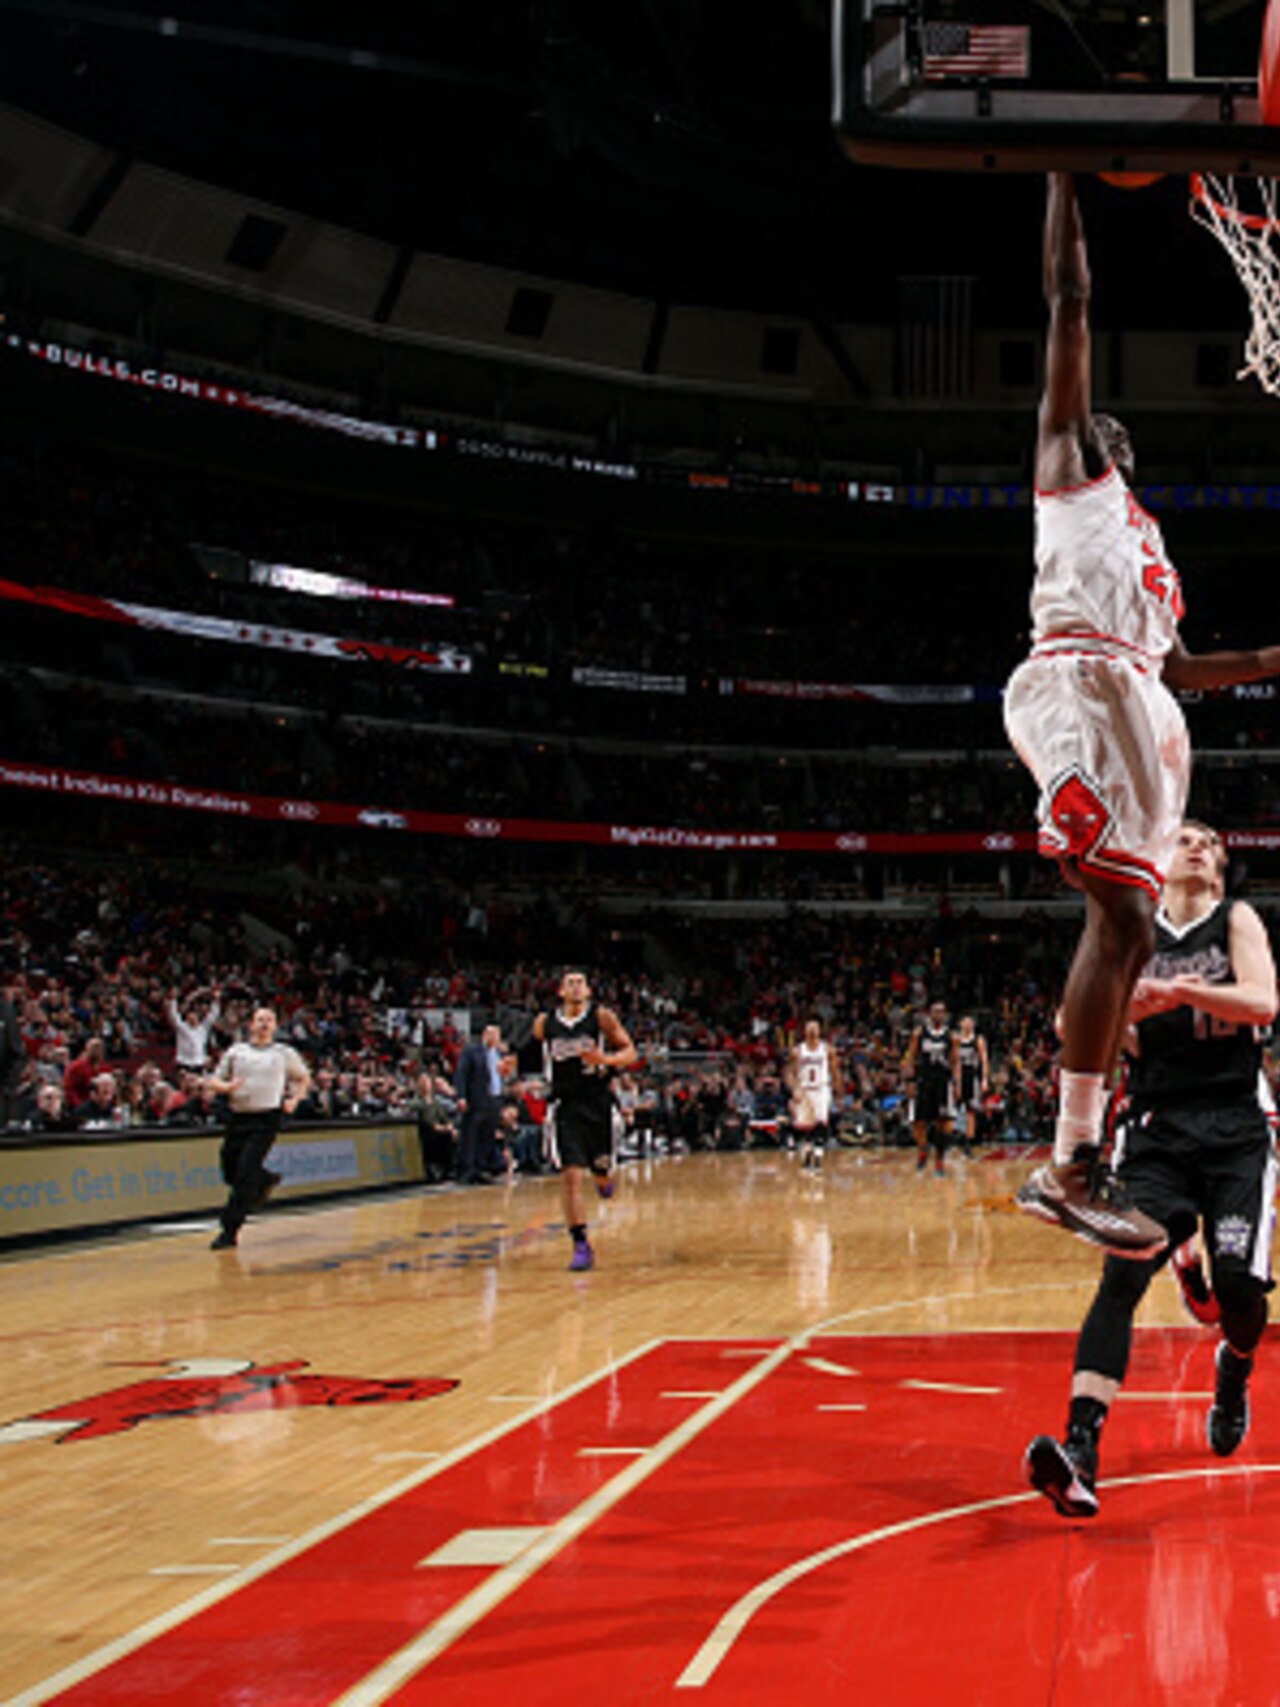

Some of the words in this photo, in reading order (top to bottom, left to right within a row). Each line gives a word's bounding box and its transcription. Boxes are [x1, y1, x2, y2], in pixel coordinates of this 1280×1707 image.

[45, 342, 200, 397] BULLS.COM
[71, 1166, 116, 1202] Get
[145, 1162, 178, 1195] the
